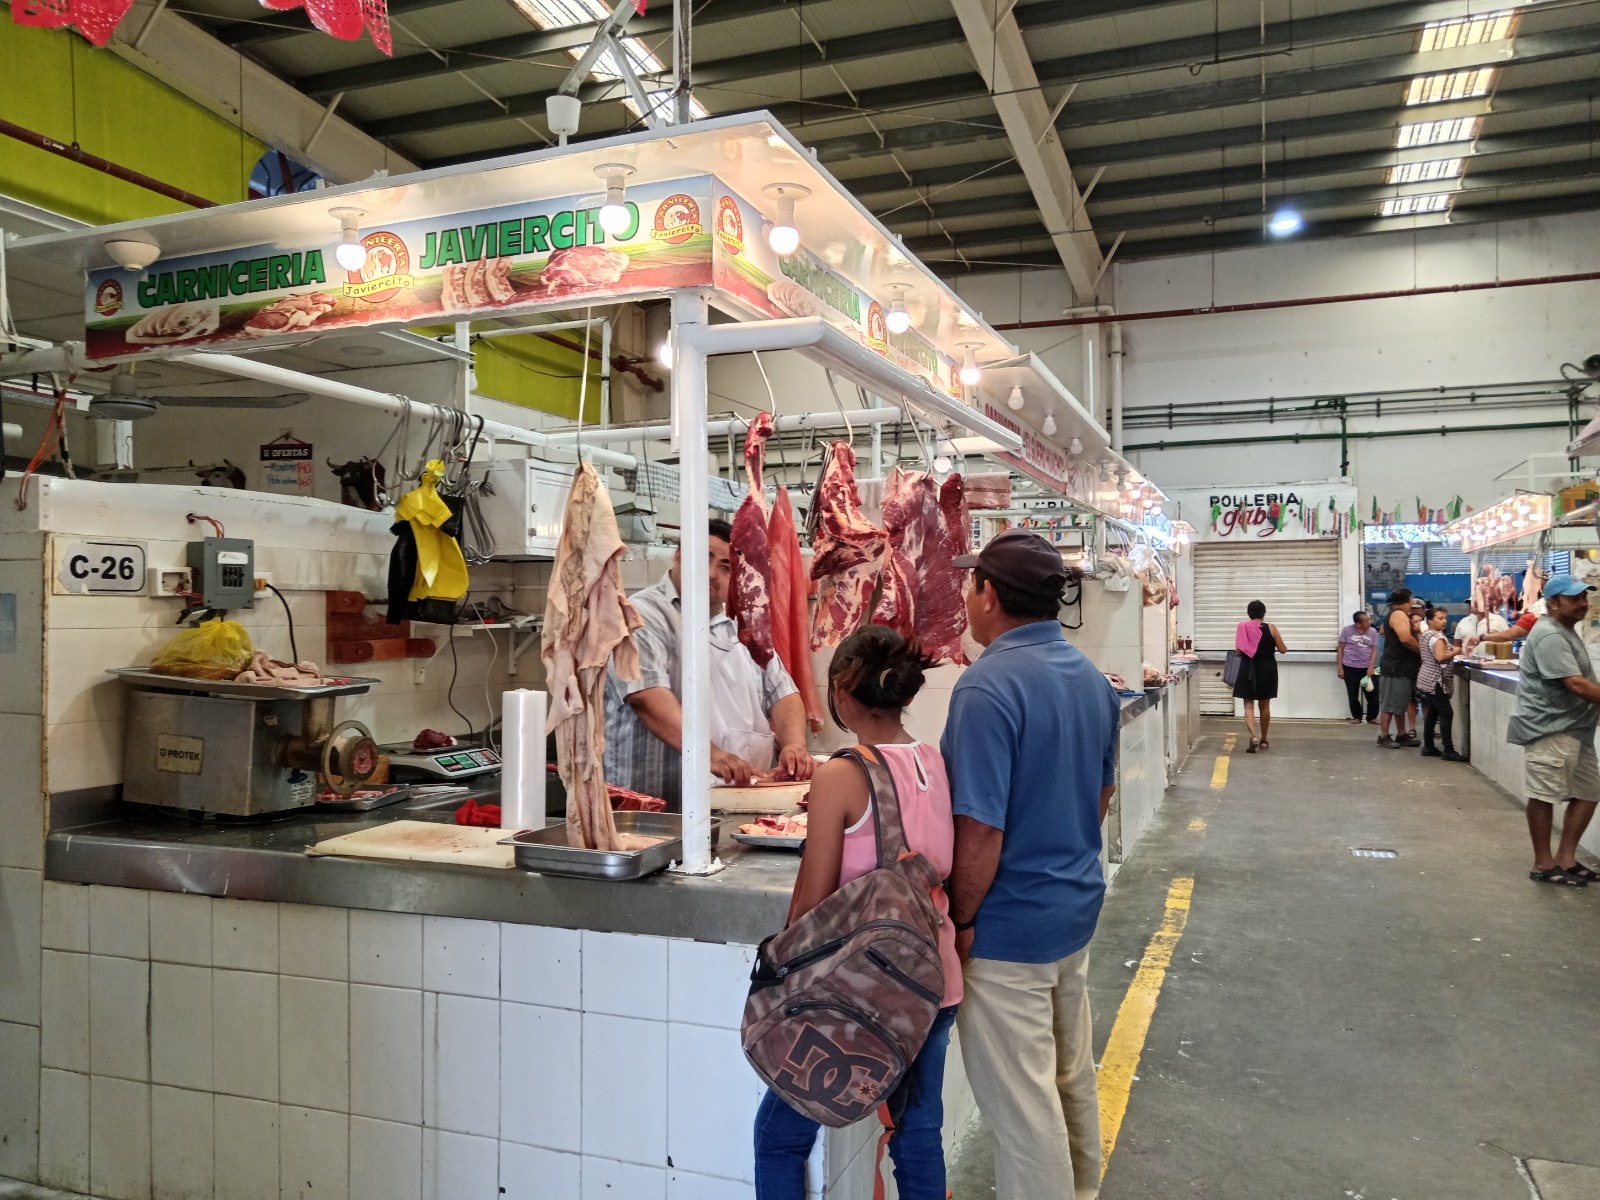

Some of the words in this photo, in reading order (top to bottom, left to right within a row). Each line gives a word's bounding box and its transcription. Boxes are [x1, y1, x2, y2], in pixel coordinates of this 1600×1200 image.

[657, 196, 697, 224] CARNICERIA
[652, 224, 700, 239] Javiercito
[137, 249, 326, 309] CARNICERIA
[419, 200, 640, 270] JAVIERCITO
[364, 235, 407, 270] NICERIA
[345, 276, 410, 295] Javiercito
[271, 448, 309, 458] OFERTAS
[1209, 492, 1300, 508] POLLERIA
[69, 554, 135, 581] C-26
[167, 749, 201, 761] PROTEK
